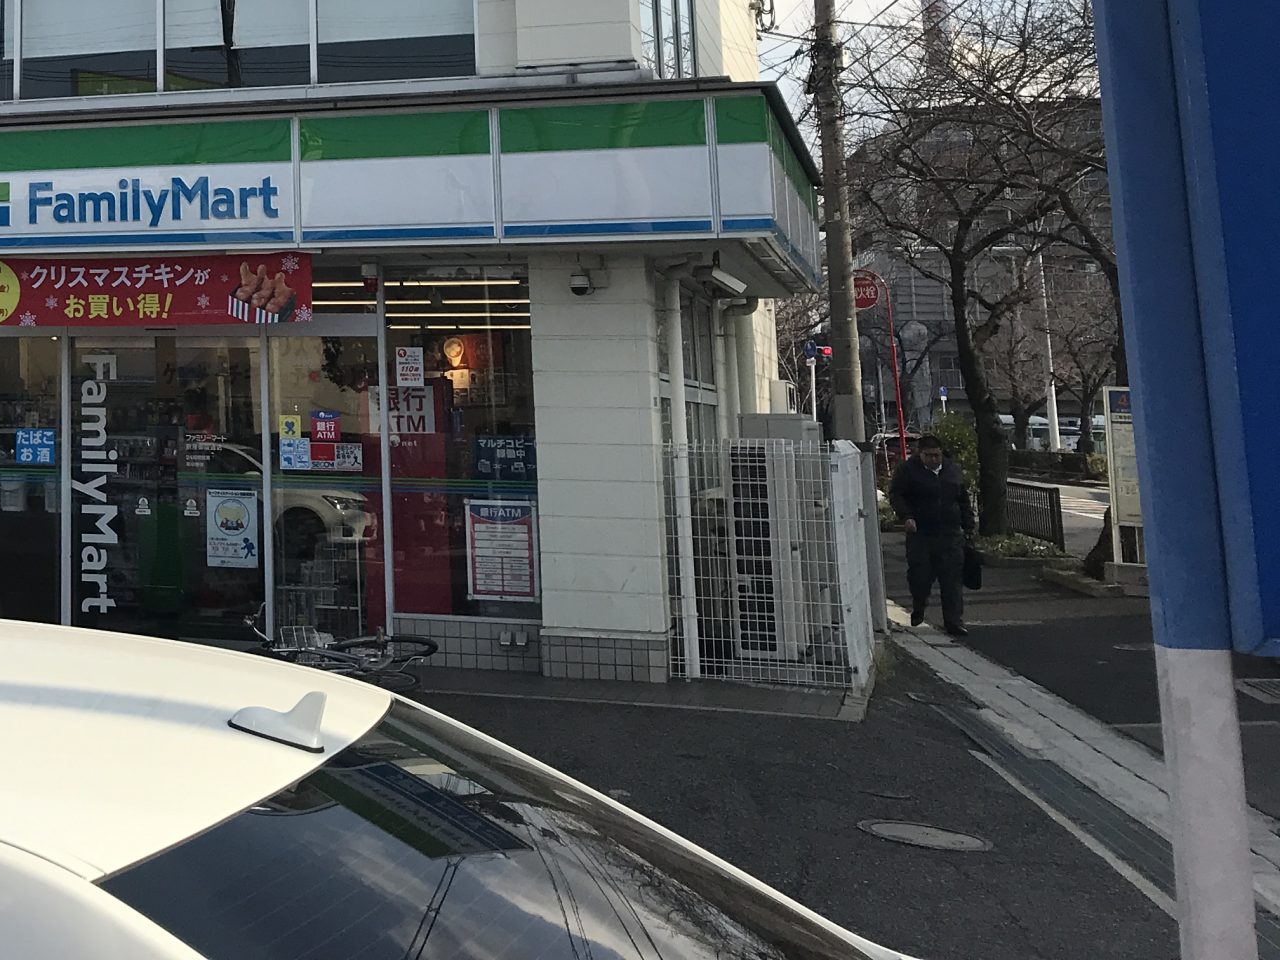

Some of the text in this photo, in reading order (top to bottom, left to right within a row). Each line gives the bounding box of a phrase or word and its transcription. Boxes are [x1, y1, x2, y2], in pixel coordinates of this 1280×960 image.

[28, 176, 280, 228] FamilyMart
[29, 263, 210, 290] クリスマスチキンが
[316, 421, 336, 431] 銀行
[16, 430, 55, 445] たばこ
[316, 431, 336, 439] ATM
[478, 439, 538, 448] マルチコピー
[71, 353, 119, 615] FamilyMart
